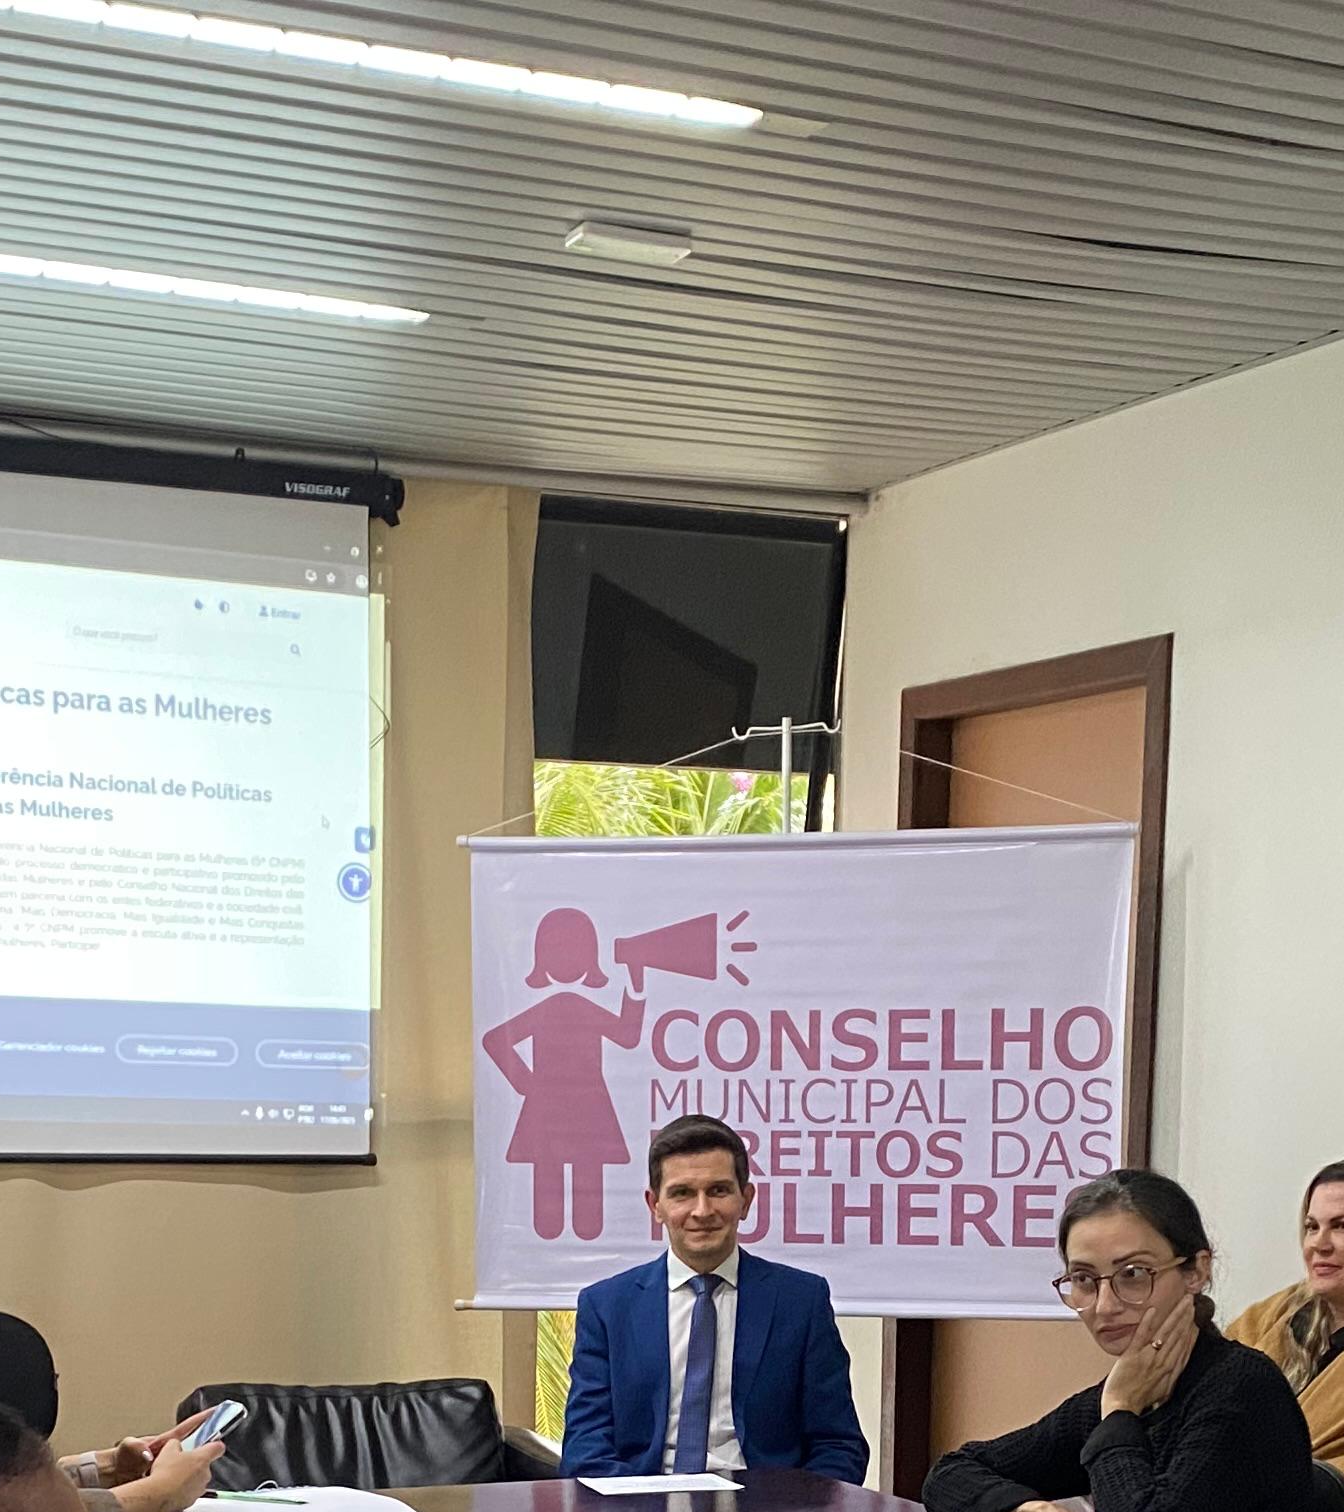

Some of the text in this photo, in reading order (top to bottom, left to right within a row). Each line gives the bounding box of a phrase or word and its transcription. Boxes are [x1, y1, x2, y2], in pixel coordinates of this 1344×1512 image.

[285, 482, 350, 498] VISOGRAF
[53, 688, 112, 714] para
[118, 696, 147, 715] as
[154, 693, 272, 725] Mulheres
[69, 771, 157, 796] Nacional
[161, 776, 188, 798] de
[191, 779, 273, 804] Políticas
[20, 799, 114, 823] Mulheres
[650, 1005, 1114, 1072] CONSELHO
[650, 1077, 1113, 1125] MUNICIPAL DOS
[991, 1130, 1113, 1179] DAS
[650, 1183, 1096, 1248] ULHERE
